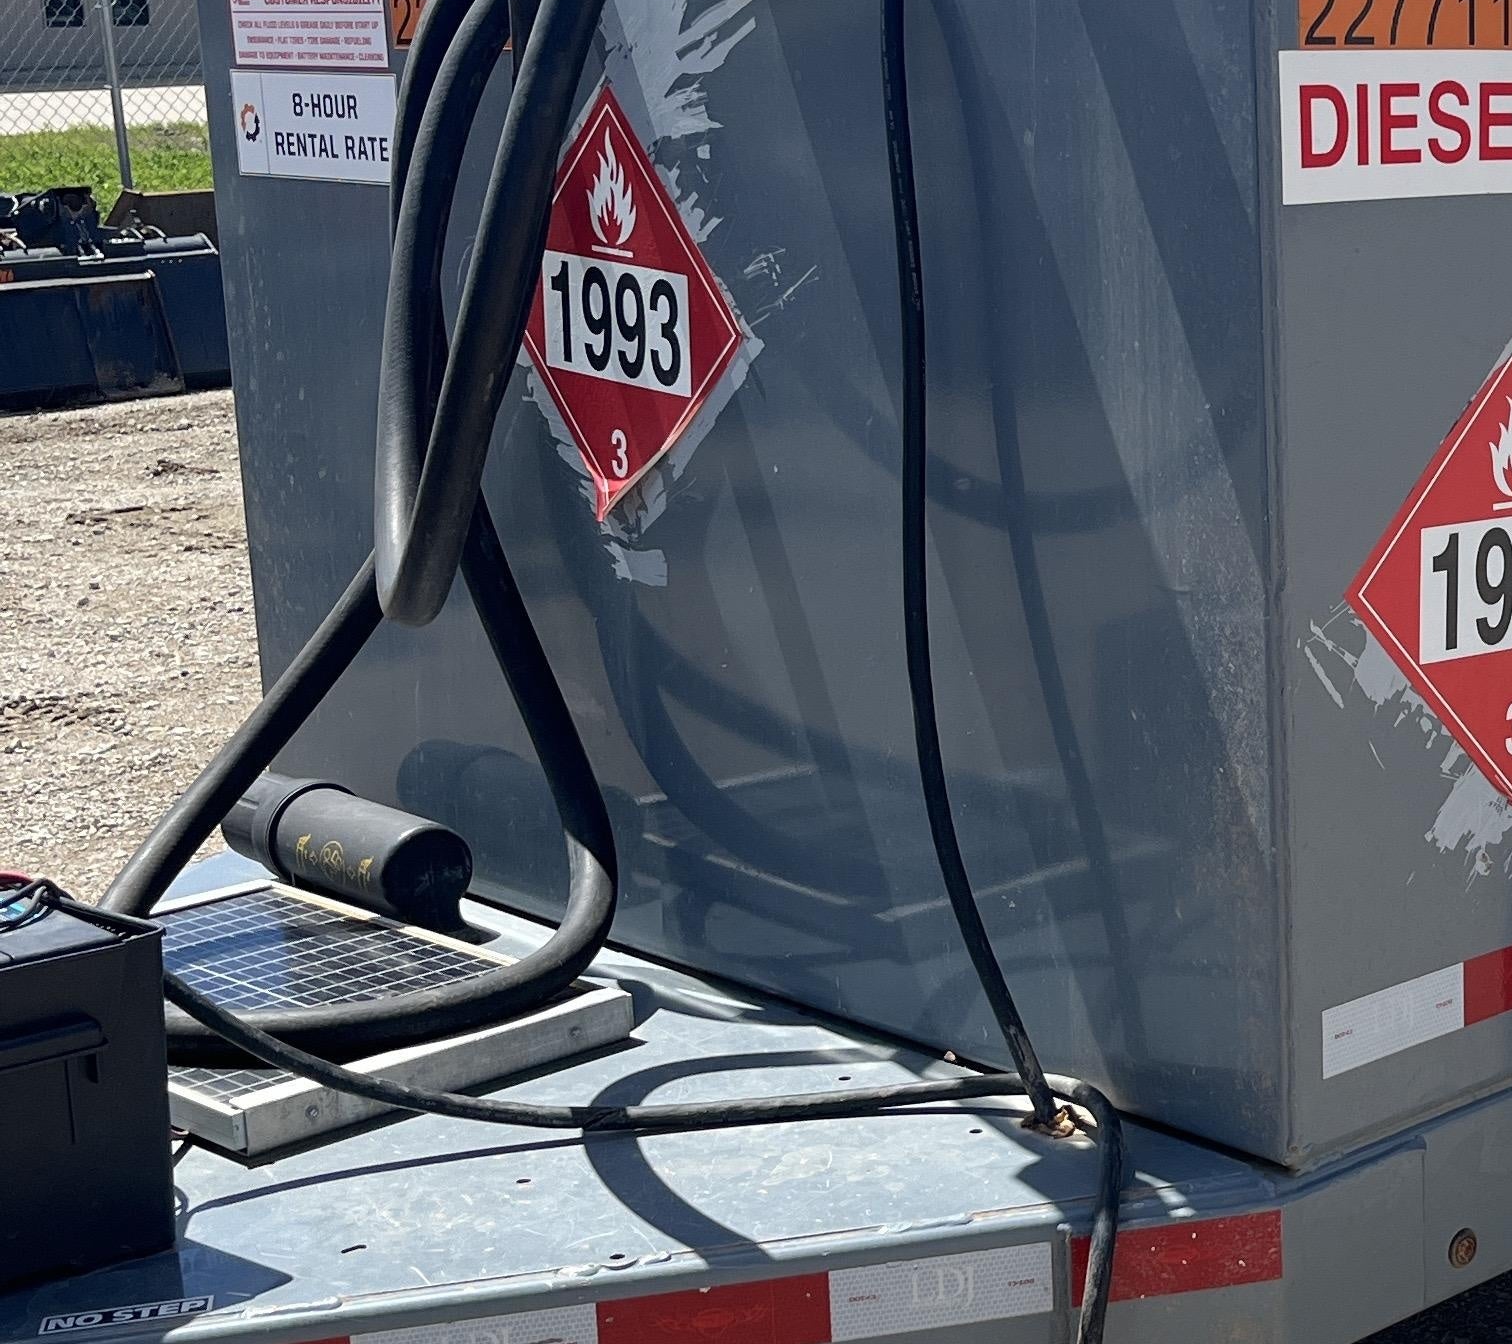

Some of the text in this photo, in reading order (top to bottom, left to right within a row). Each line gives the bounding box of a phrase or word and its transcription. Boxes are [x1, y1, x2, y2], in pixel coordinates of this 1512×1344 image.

[292, 92, 358, 121] 8-HOUR
[274, 131, 390, 163] RENTAL RATE
[550, 260, 682, 387] 1993
[610, 428, 629, 477] 3
[47, 1299, 207, 1331] NO STEP
